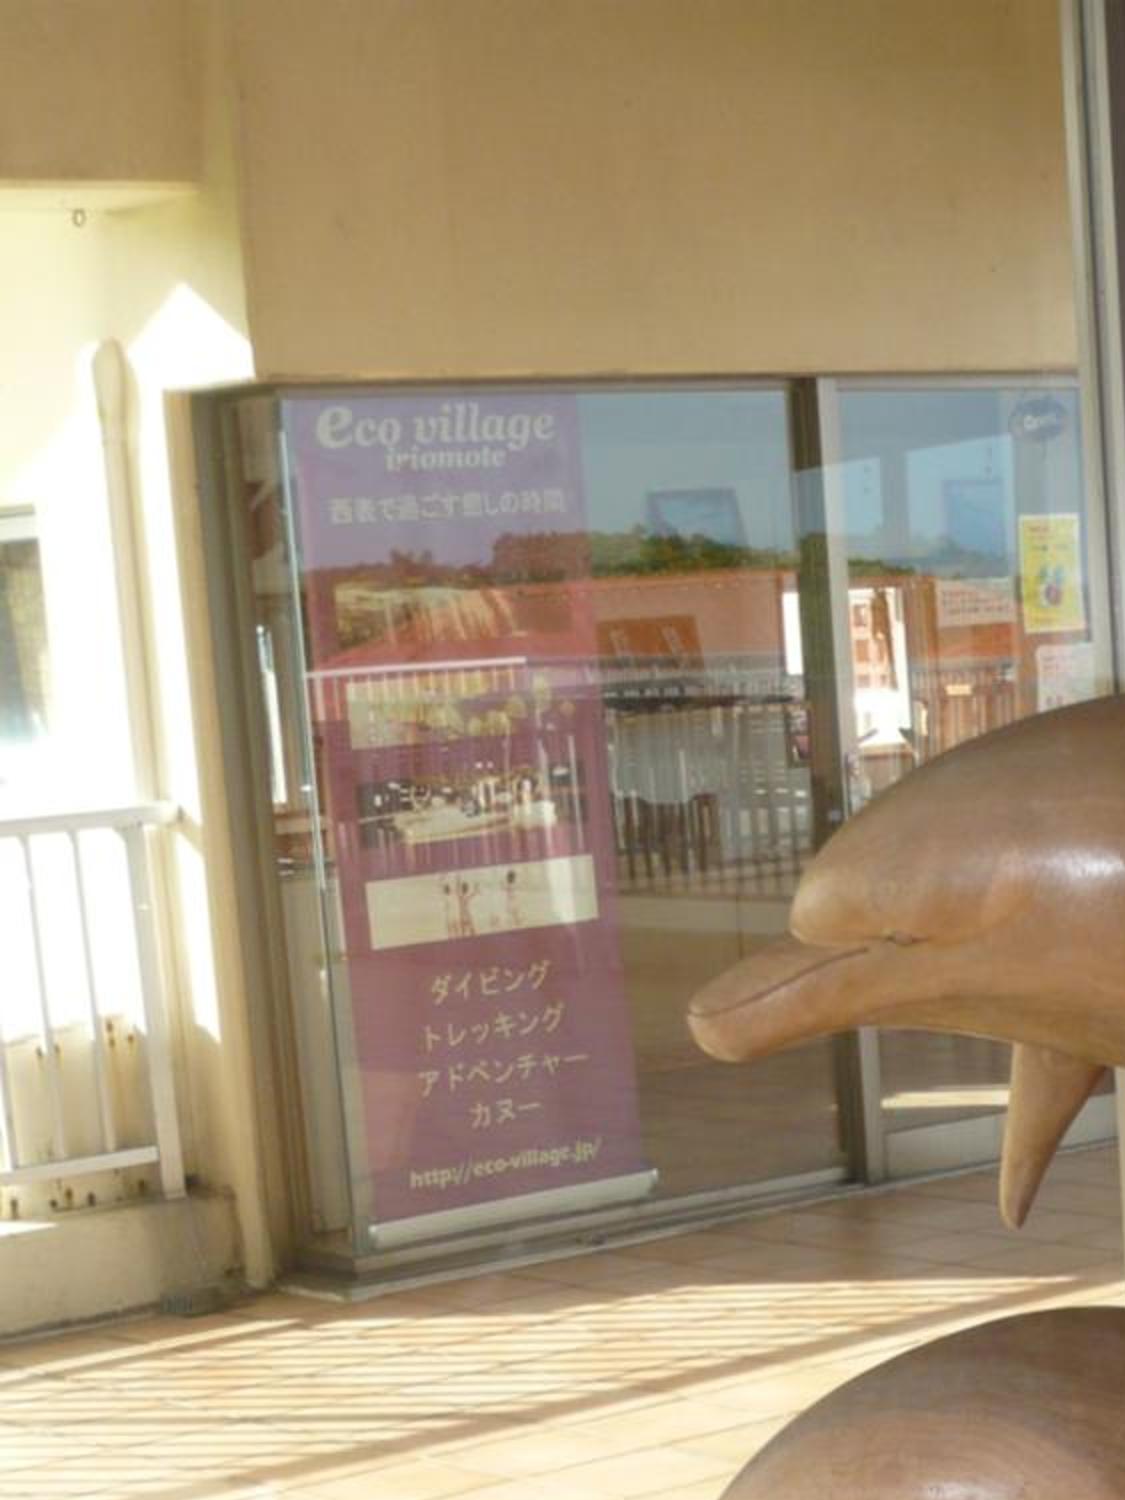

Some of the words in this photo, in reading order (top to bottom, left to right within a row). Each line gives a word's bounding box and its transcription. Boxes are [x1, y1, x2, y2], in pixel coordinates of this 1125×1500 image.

[316, 405, 402, 449] eco
[413, 401, 555, 451] village
[430, 960, 550, 1005] ダイビング
[422, 1002, 563, 1051] トレッキング
[418, 1052, 588, 1097] アドベンチャー
[468, 1097, 542, 1130] カヌー
